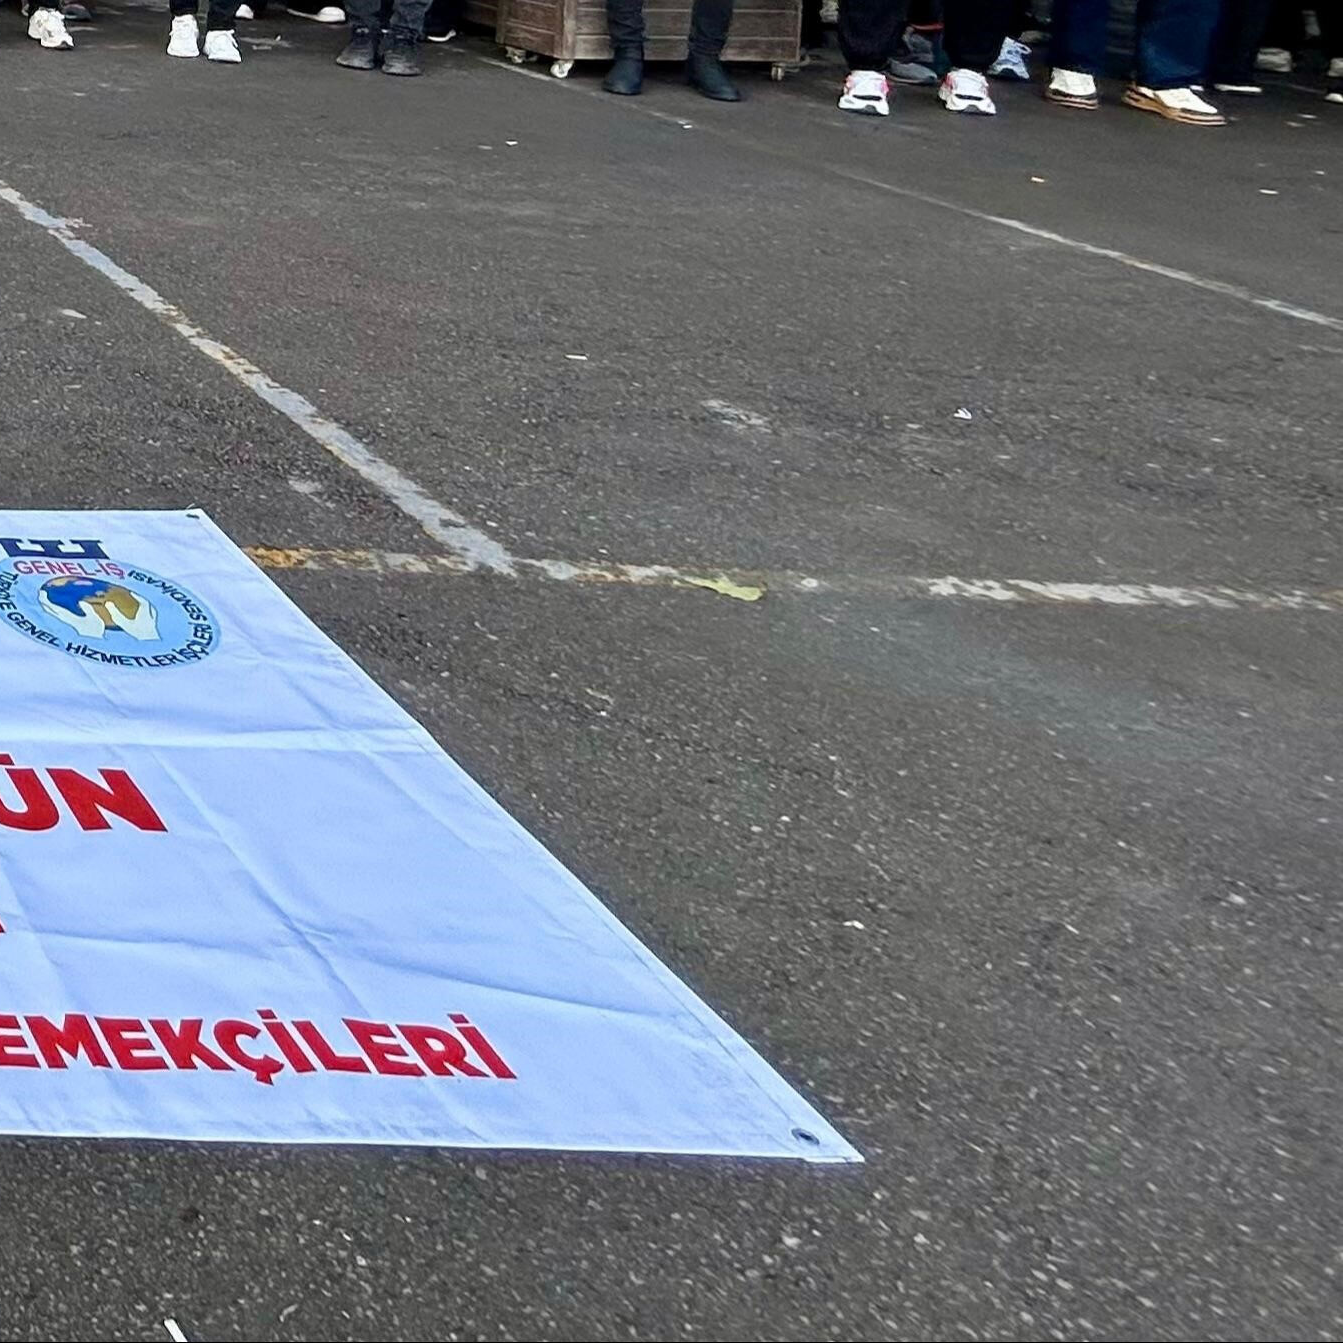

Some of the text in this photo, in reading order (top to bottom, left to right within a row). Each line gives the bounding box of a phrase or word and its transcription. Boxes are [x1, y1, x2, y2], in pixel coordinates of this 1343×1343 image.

[13, 560, 126, 581] GENEL-İŞ
[6, 609, 61, 648] GENEL
[66, 641, 179, 668] HİZMETLER
[127, 569, 209, 623] SENDİKASI
